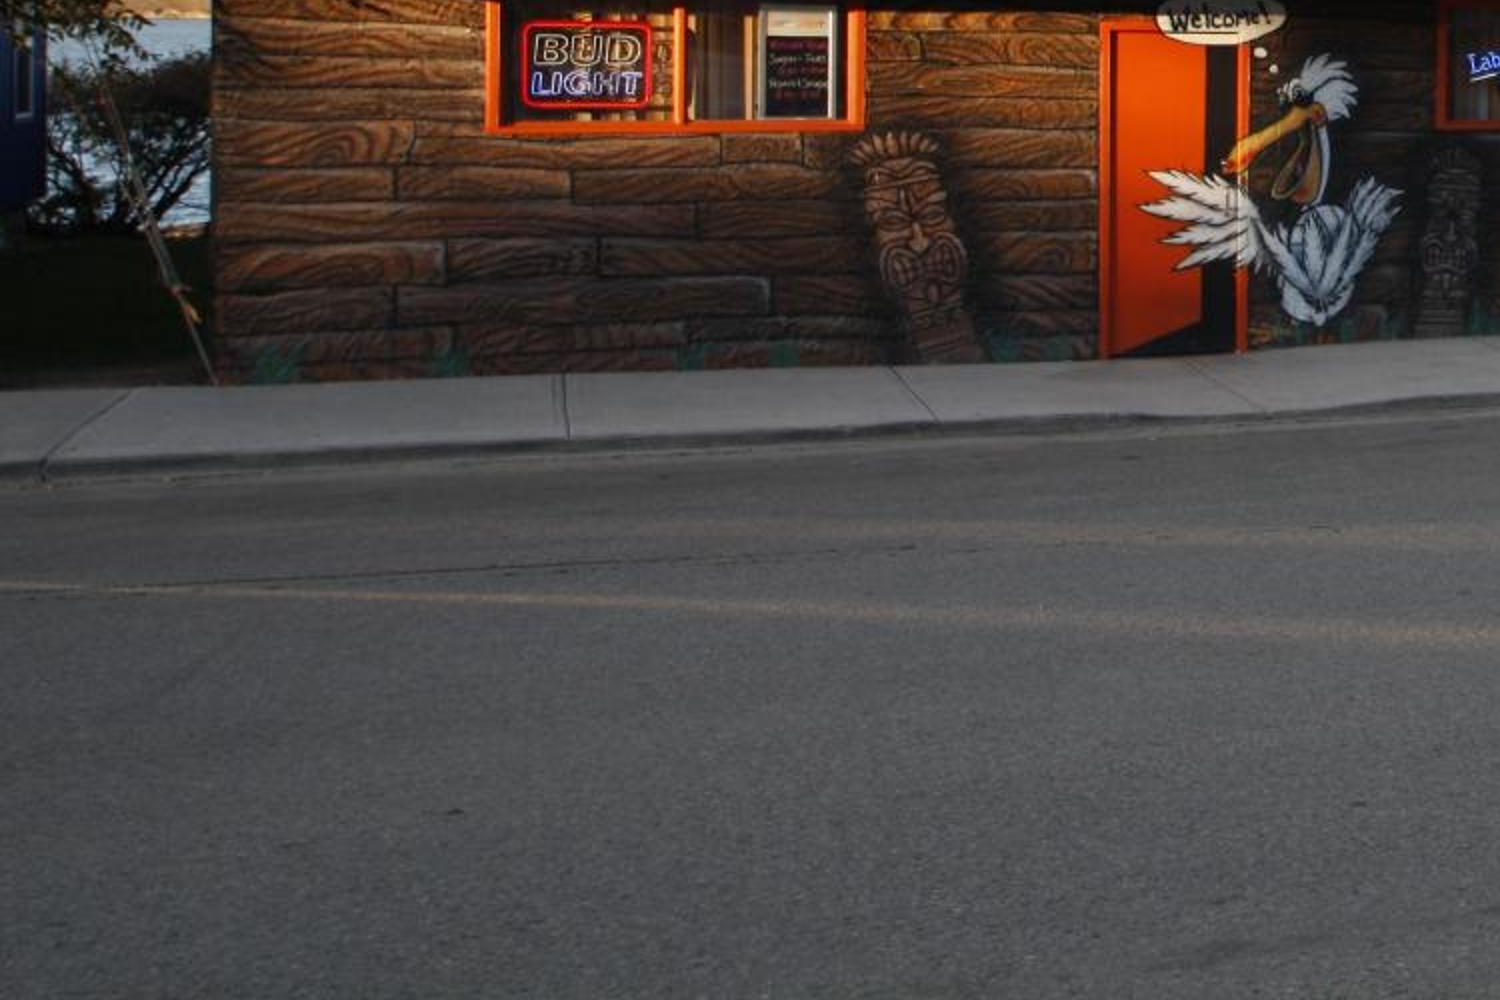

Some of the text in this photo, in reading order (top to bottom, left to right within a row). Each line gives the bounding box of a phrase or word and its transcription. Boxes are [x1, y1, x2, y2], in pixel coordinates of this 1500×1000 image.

[1166, 1, 1272, 31] Welcome!
[533, 33, 641, 66] BUD
[531, 71, 642, 96] LIGHT
